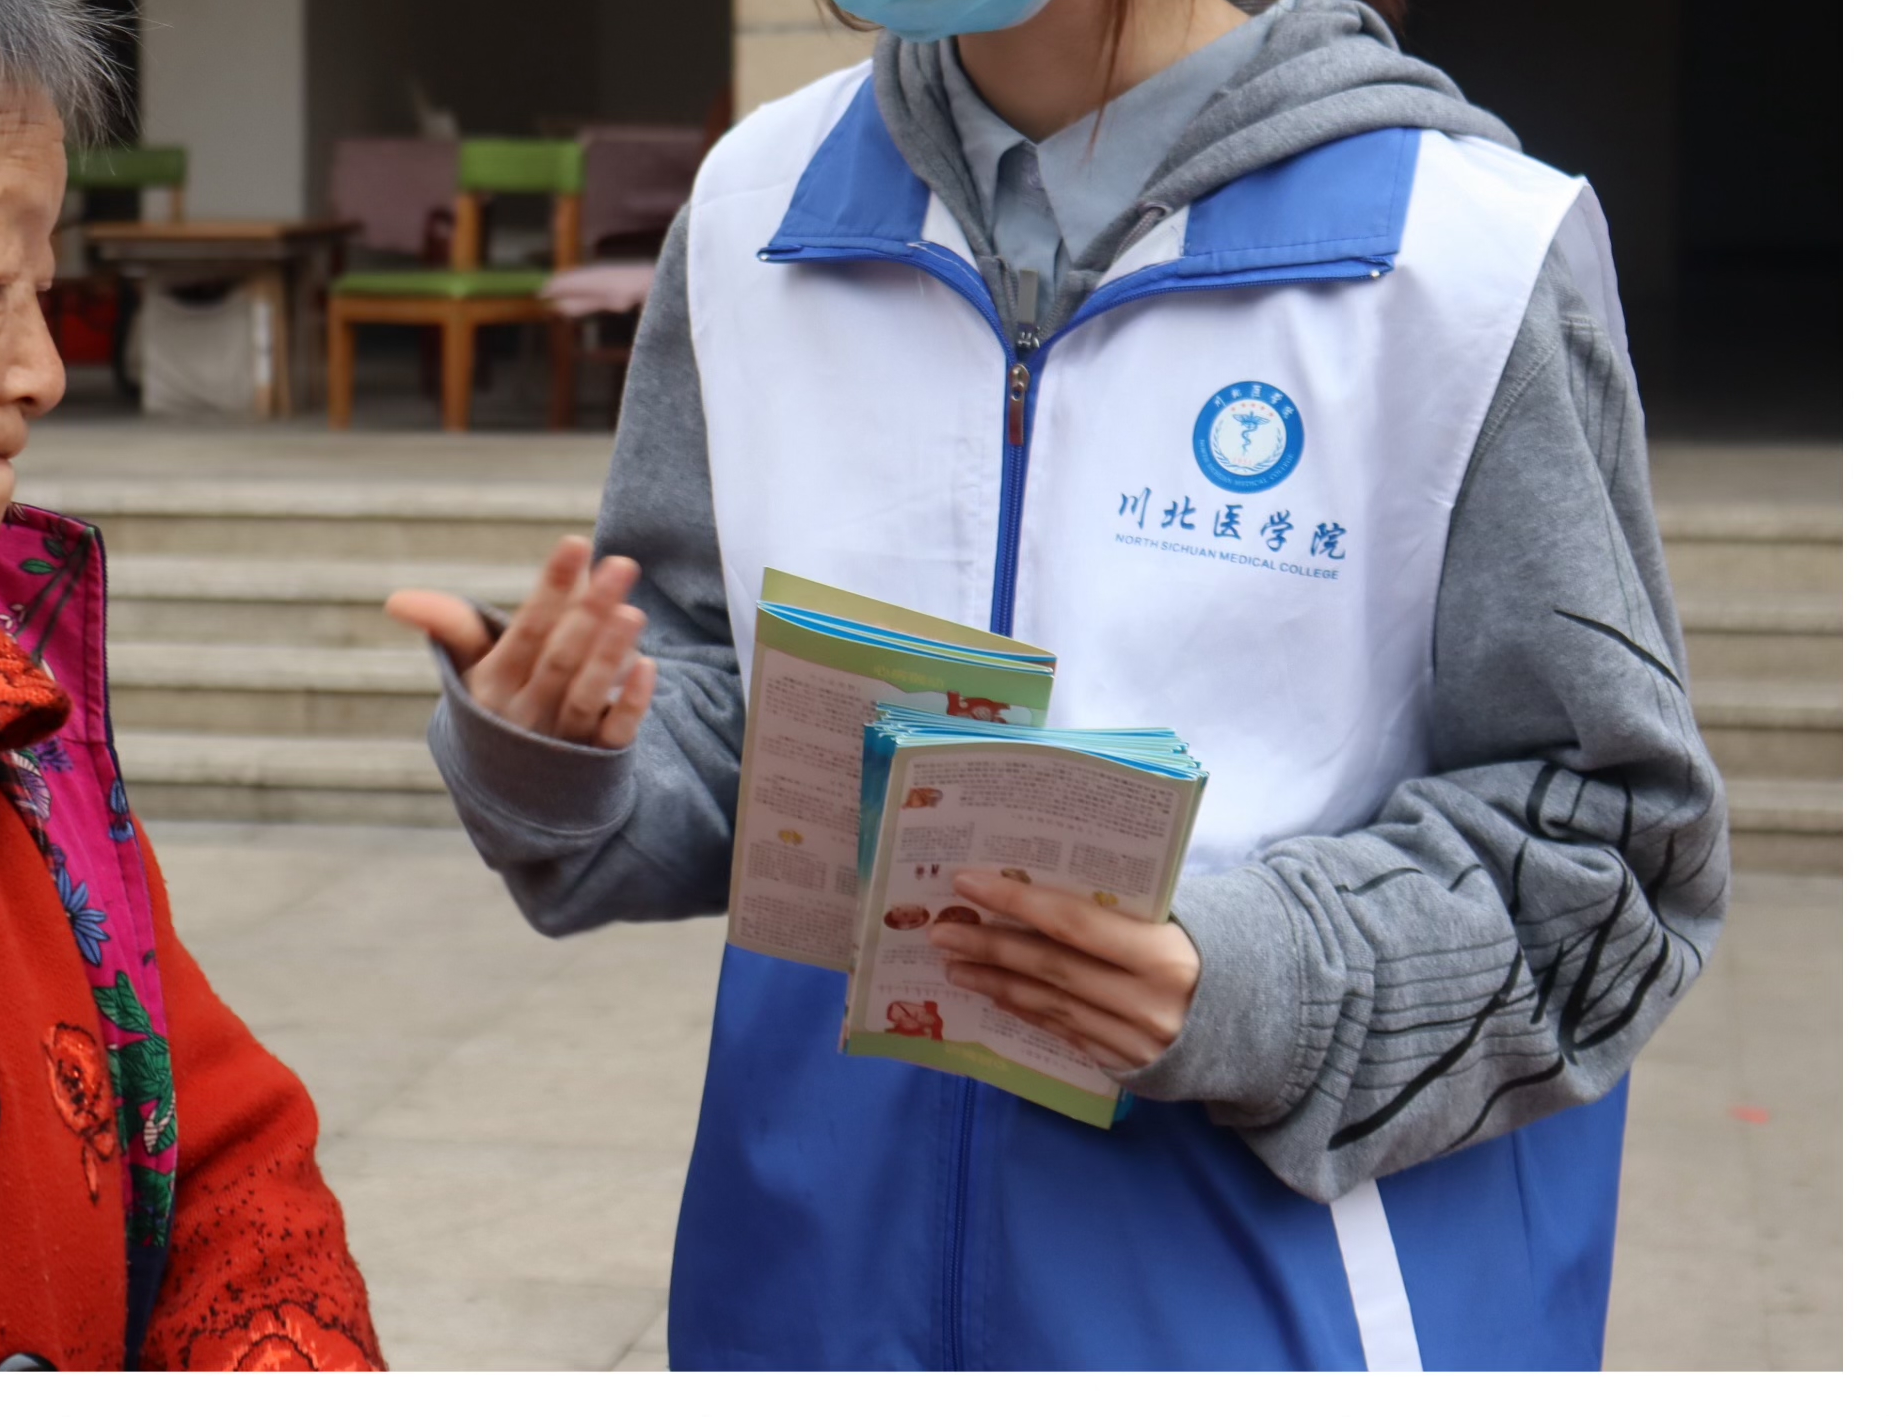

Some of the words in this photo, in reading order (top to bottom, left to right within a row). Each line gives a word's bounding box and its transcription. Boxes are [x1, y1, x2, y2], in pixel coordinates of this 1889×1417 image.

[1118, 486, 1347, 560] 川北医学院
[1115, 533, 1159, 549] NORTH
[1160, 541, 1216, 559] SICHUAN
[1219, 551, 1277, 570] MEDICAL
[1279, 561, 1340, 580] COLLEGE
